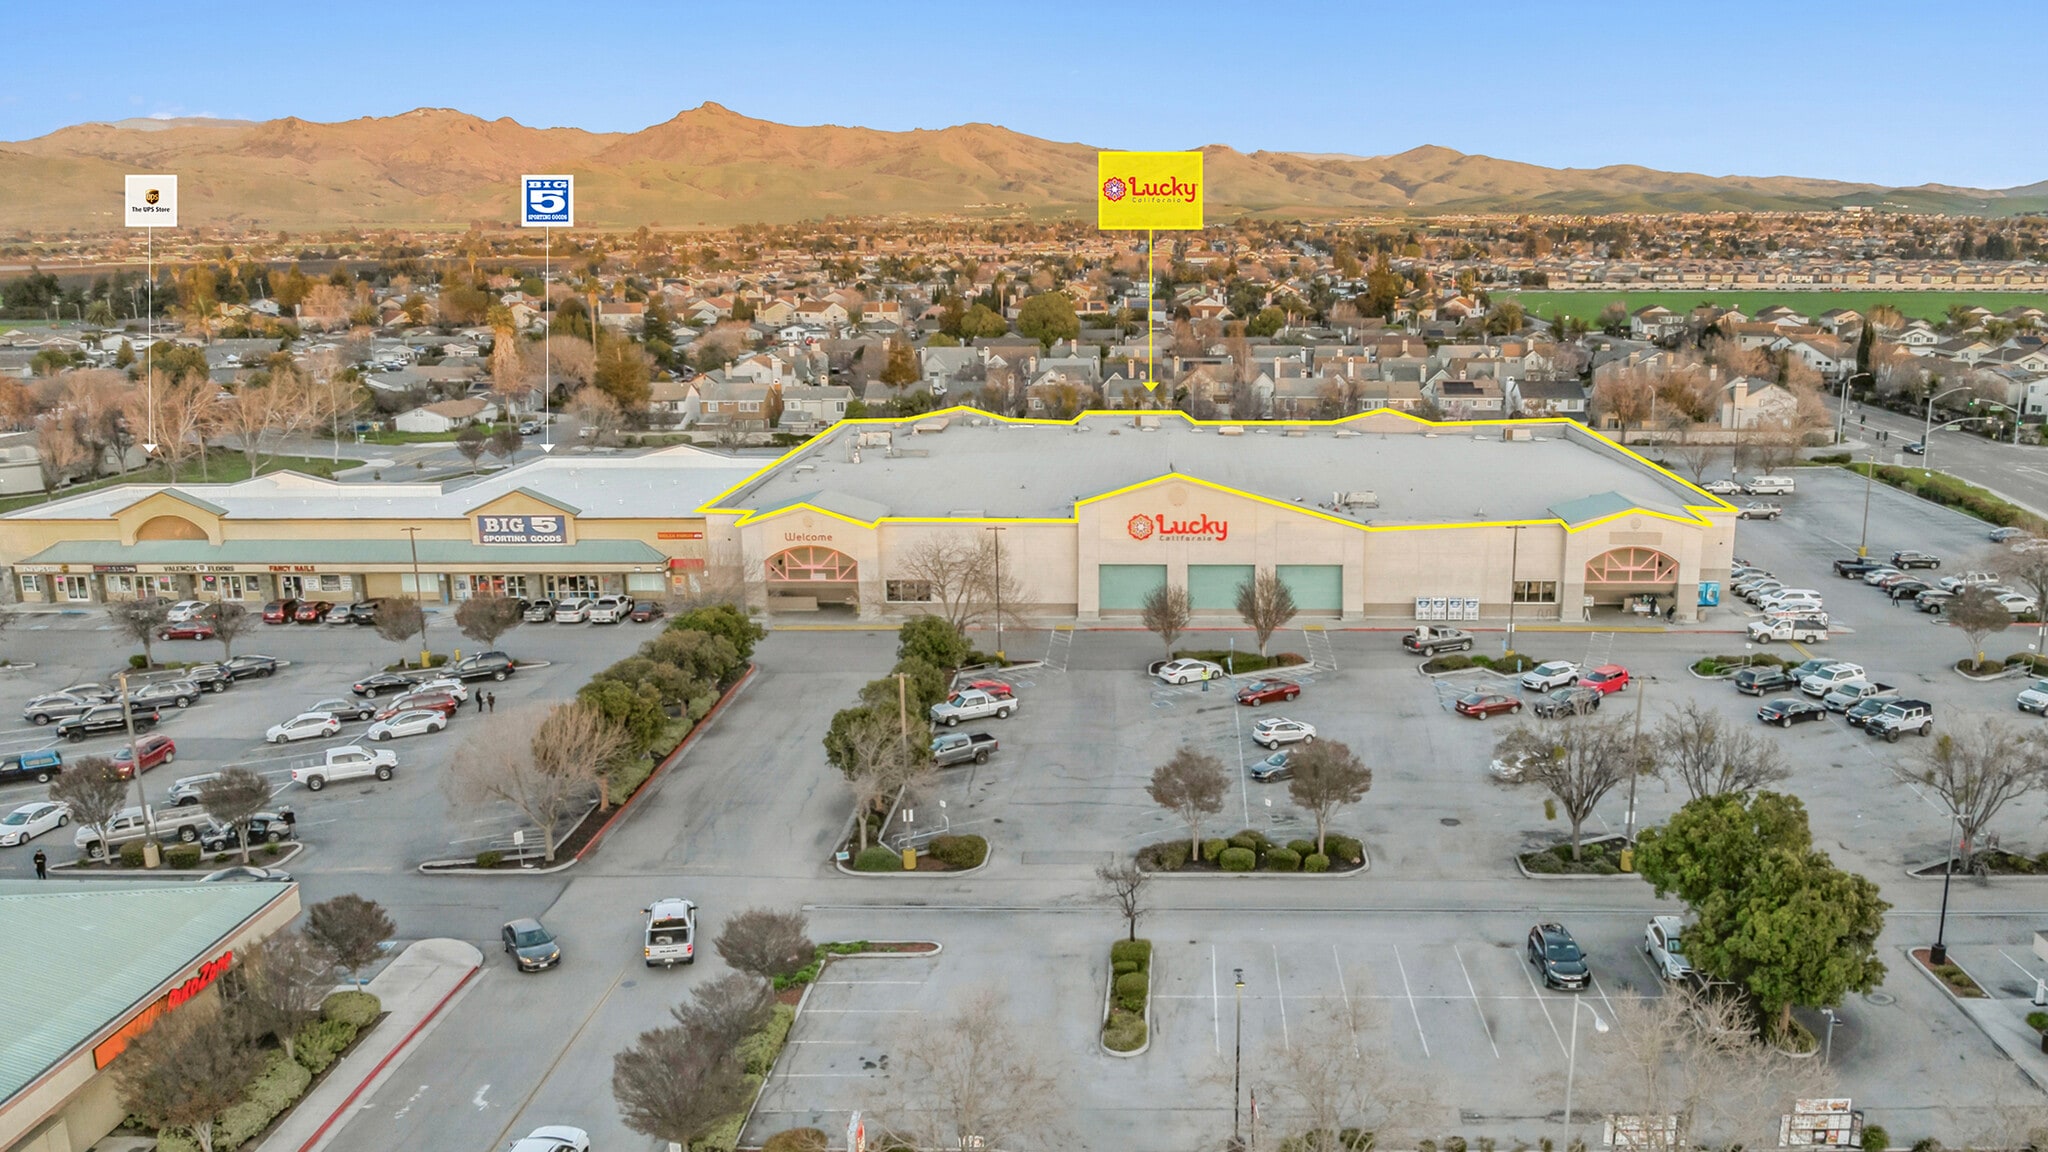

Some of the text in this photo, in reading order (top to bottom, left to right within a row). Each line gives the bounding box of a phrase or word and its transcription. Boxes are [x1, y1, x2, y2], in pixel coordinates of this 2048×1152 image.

[484, 517, 558, 533] BIG 5
[1155, 513, 1228, 541] Lucky
[483, 535, 562, 543] SPORTING GOODS
[784, 532, 833, 541] Welcome
